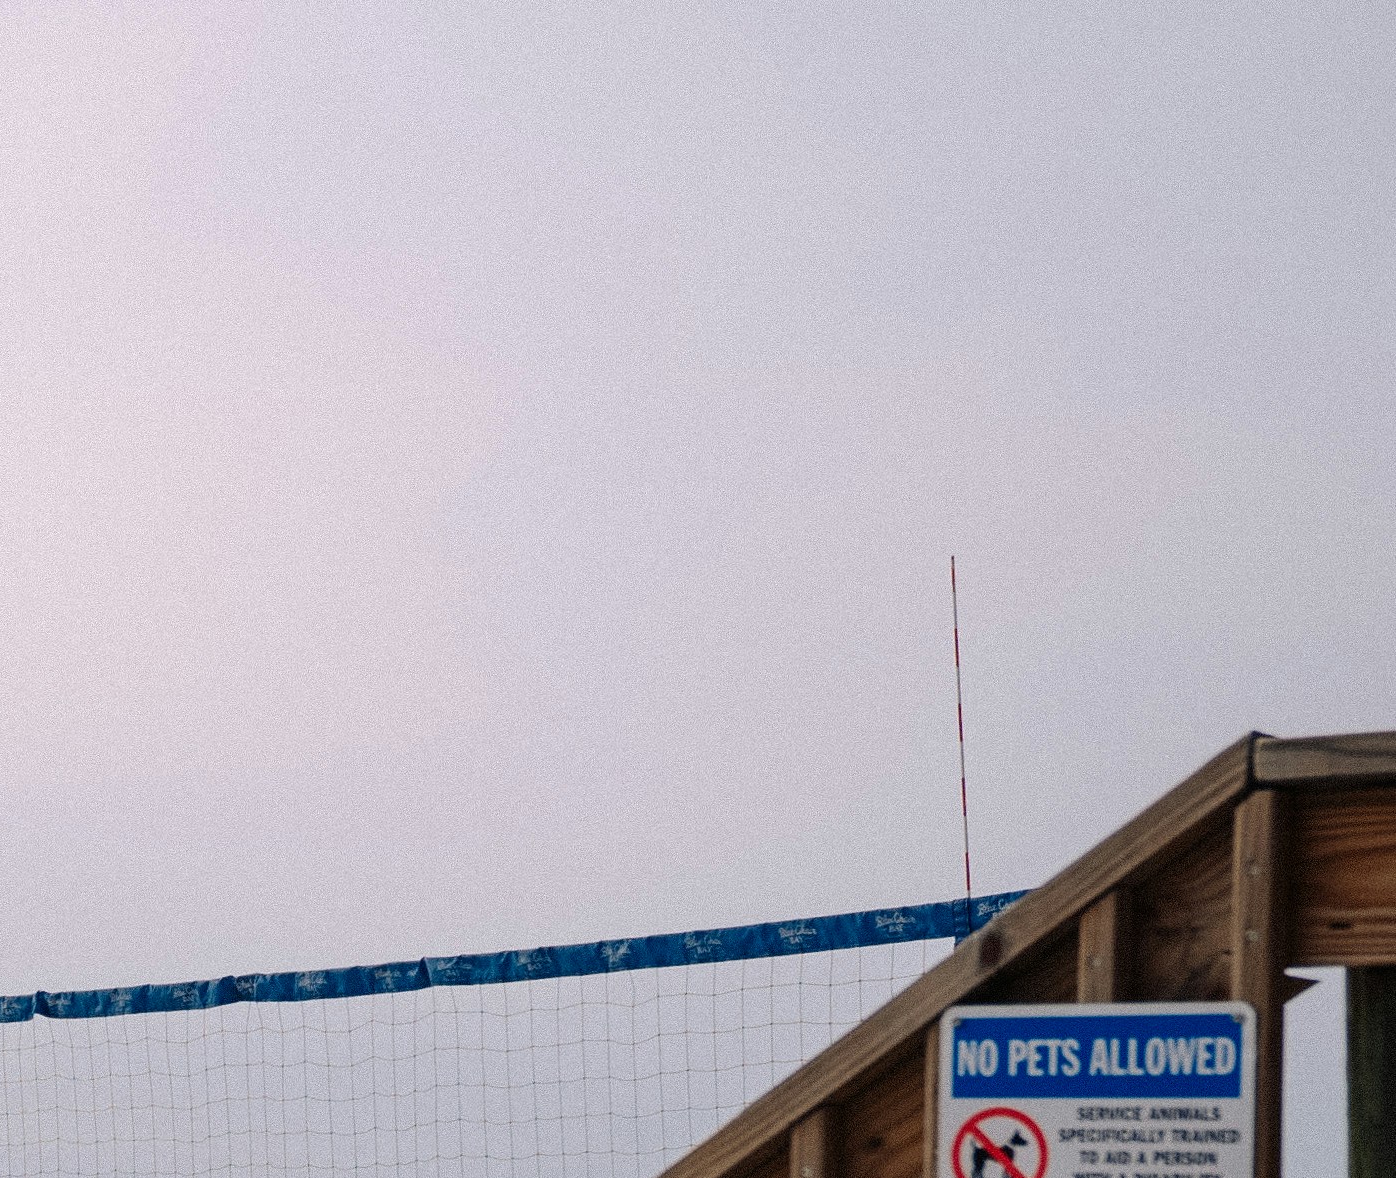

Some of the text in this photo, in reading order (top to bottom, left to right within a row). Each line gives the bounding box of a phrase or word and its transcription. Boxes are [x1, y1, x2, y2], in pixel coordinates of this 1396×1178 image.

[957, 1036, 1238, 1077] NO PETS ALLOWED
[1076, 1106, 1221, 1121] SERVICE ANIMALS
[1058, 1128, 1241, 1144] SPECIFICALLY TRAINED
[1079, 1150, 1218, 1165] TO AID A PERSON
